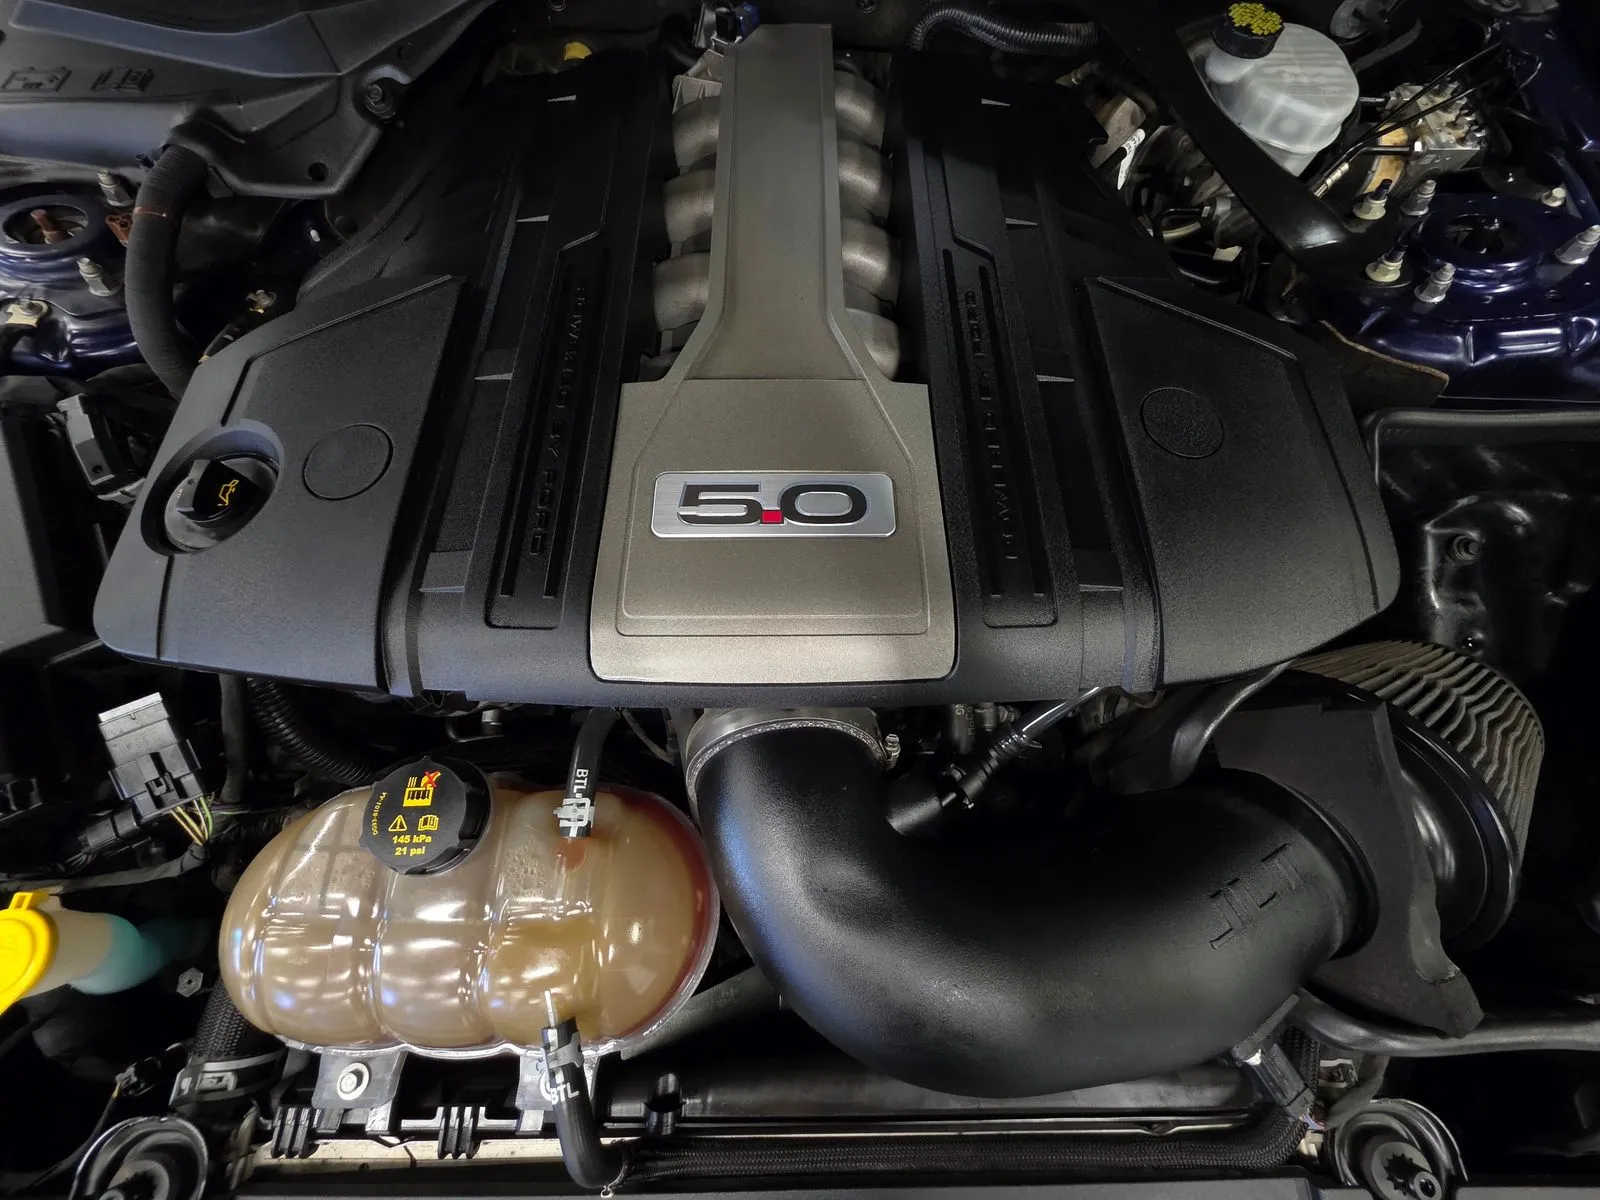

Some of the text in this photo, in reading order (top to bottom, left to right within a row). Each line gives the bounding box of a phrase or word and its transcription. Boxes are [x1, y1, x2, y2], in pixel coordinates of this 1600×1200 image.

[529, 469, 559, 556] FORD
[677, 482, 870, 526] 5.0
[392, 834, 432, 844] 145 kPa
[395, 845, 426, 857] 21 psi
